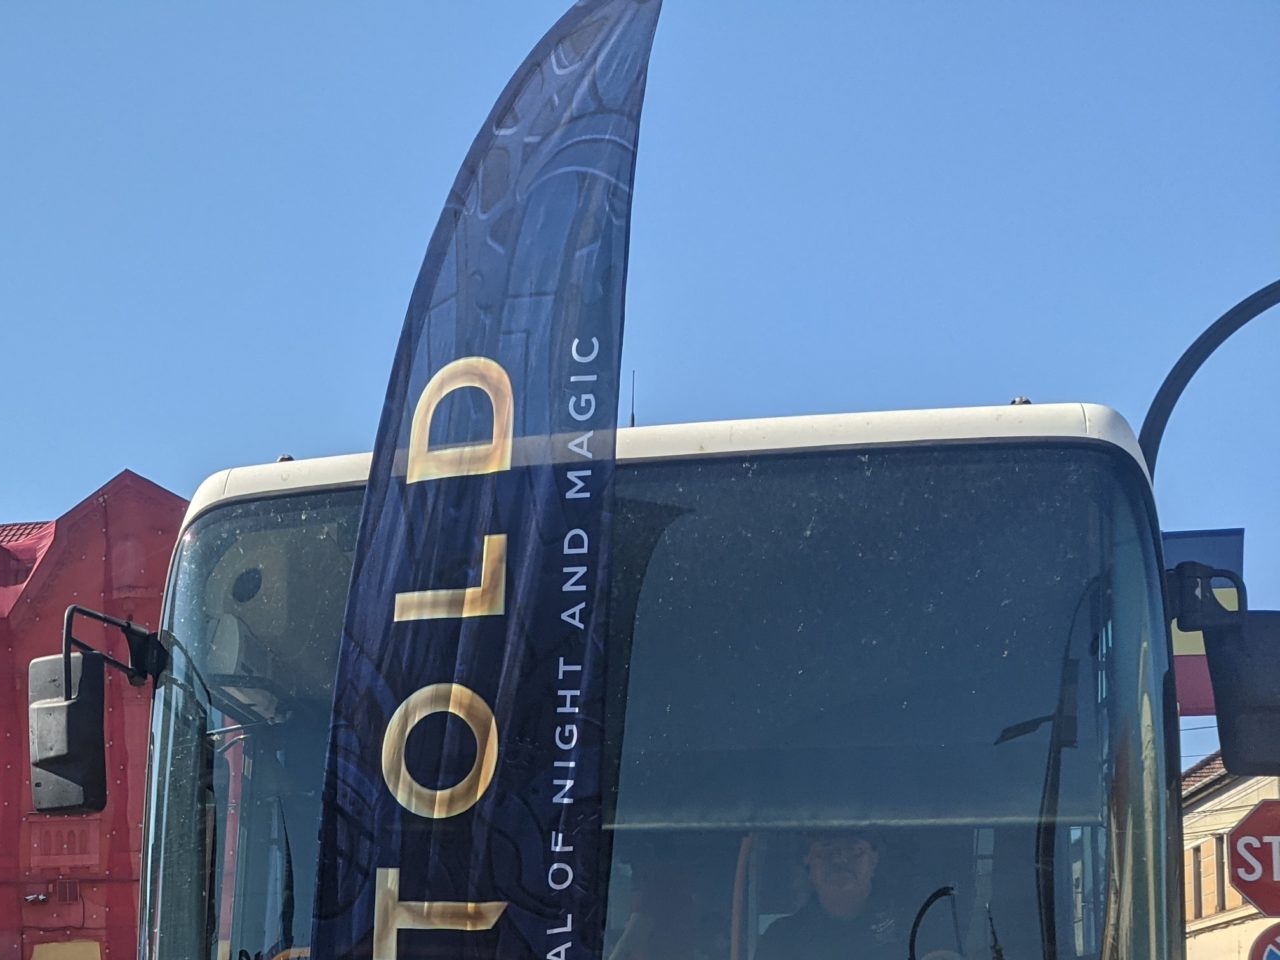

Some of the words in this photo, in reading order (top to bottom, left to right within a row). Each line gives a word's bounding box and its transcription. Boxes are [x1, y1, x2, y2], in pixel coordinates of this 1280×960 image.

[565, 336, 600, 499] MAGIC
[560, 528, 589, 630] AND
[552, 656, 582, 804] NIGHT
[548, 830, 574, 890] OF
[1236, 835, 1280, 882] ST
